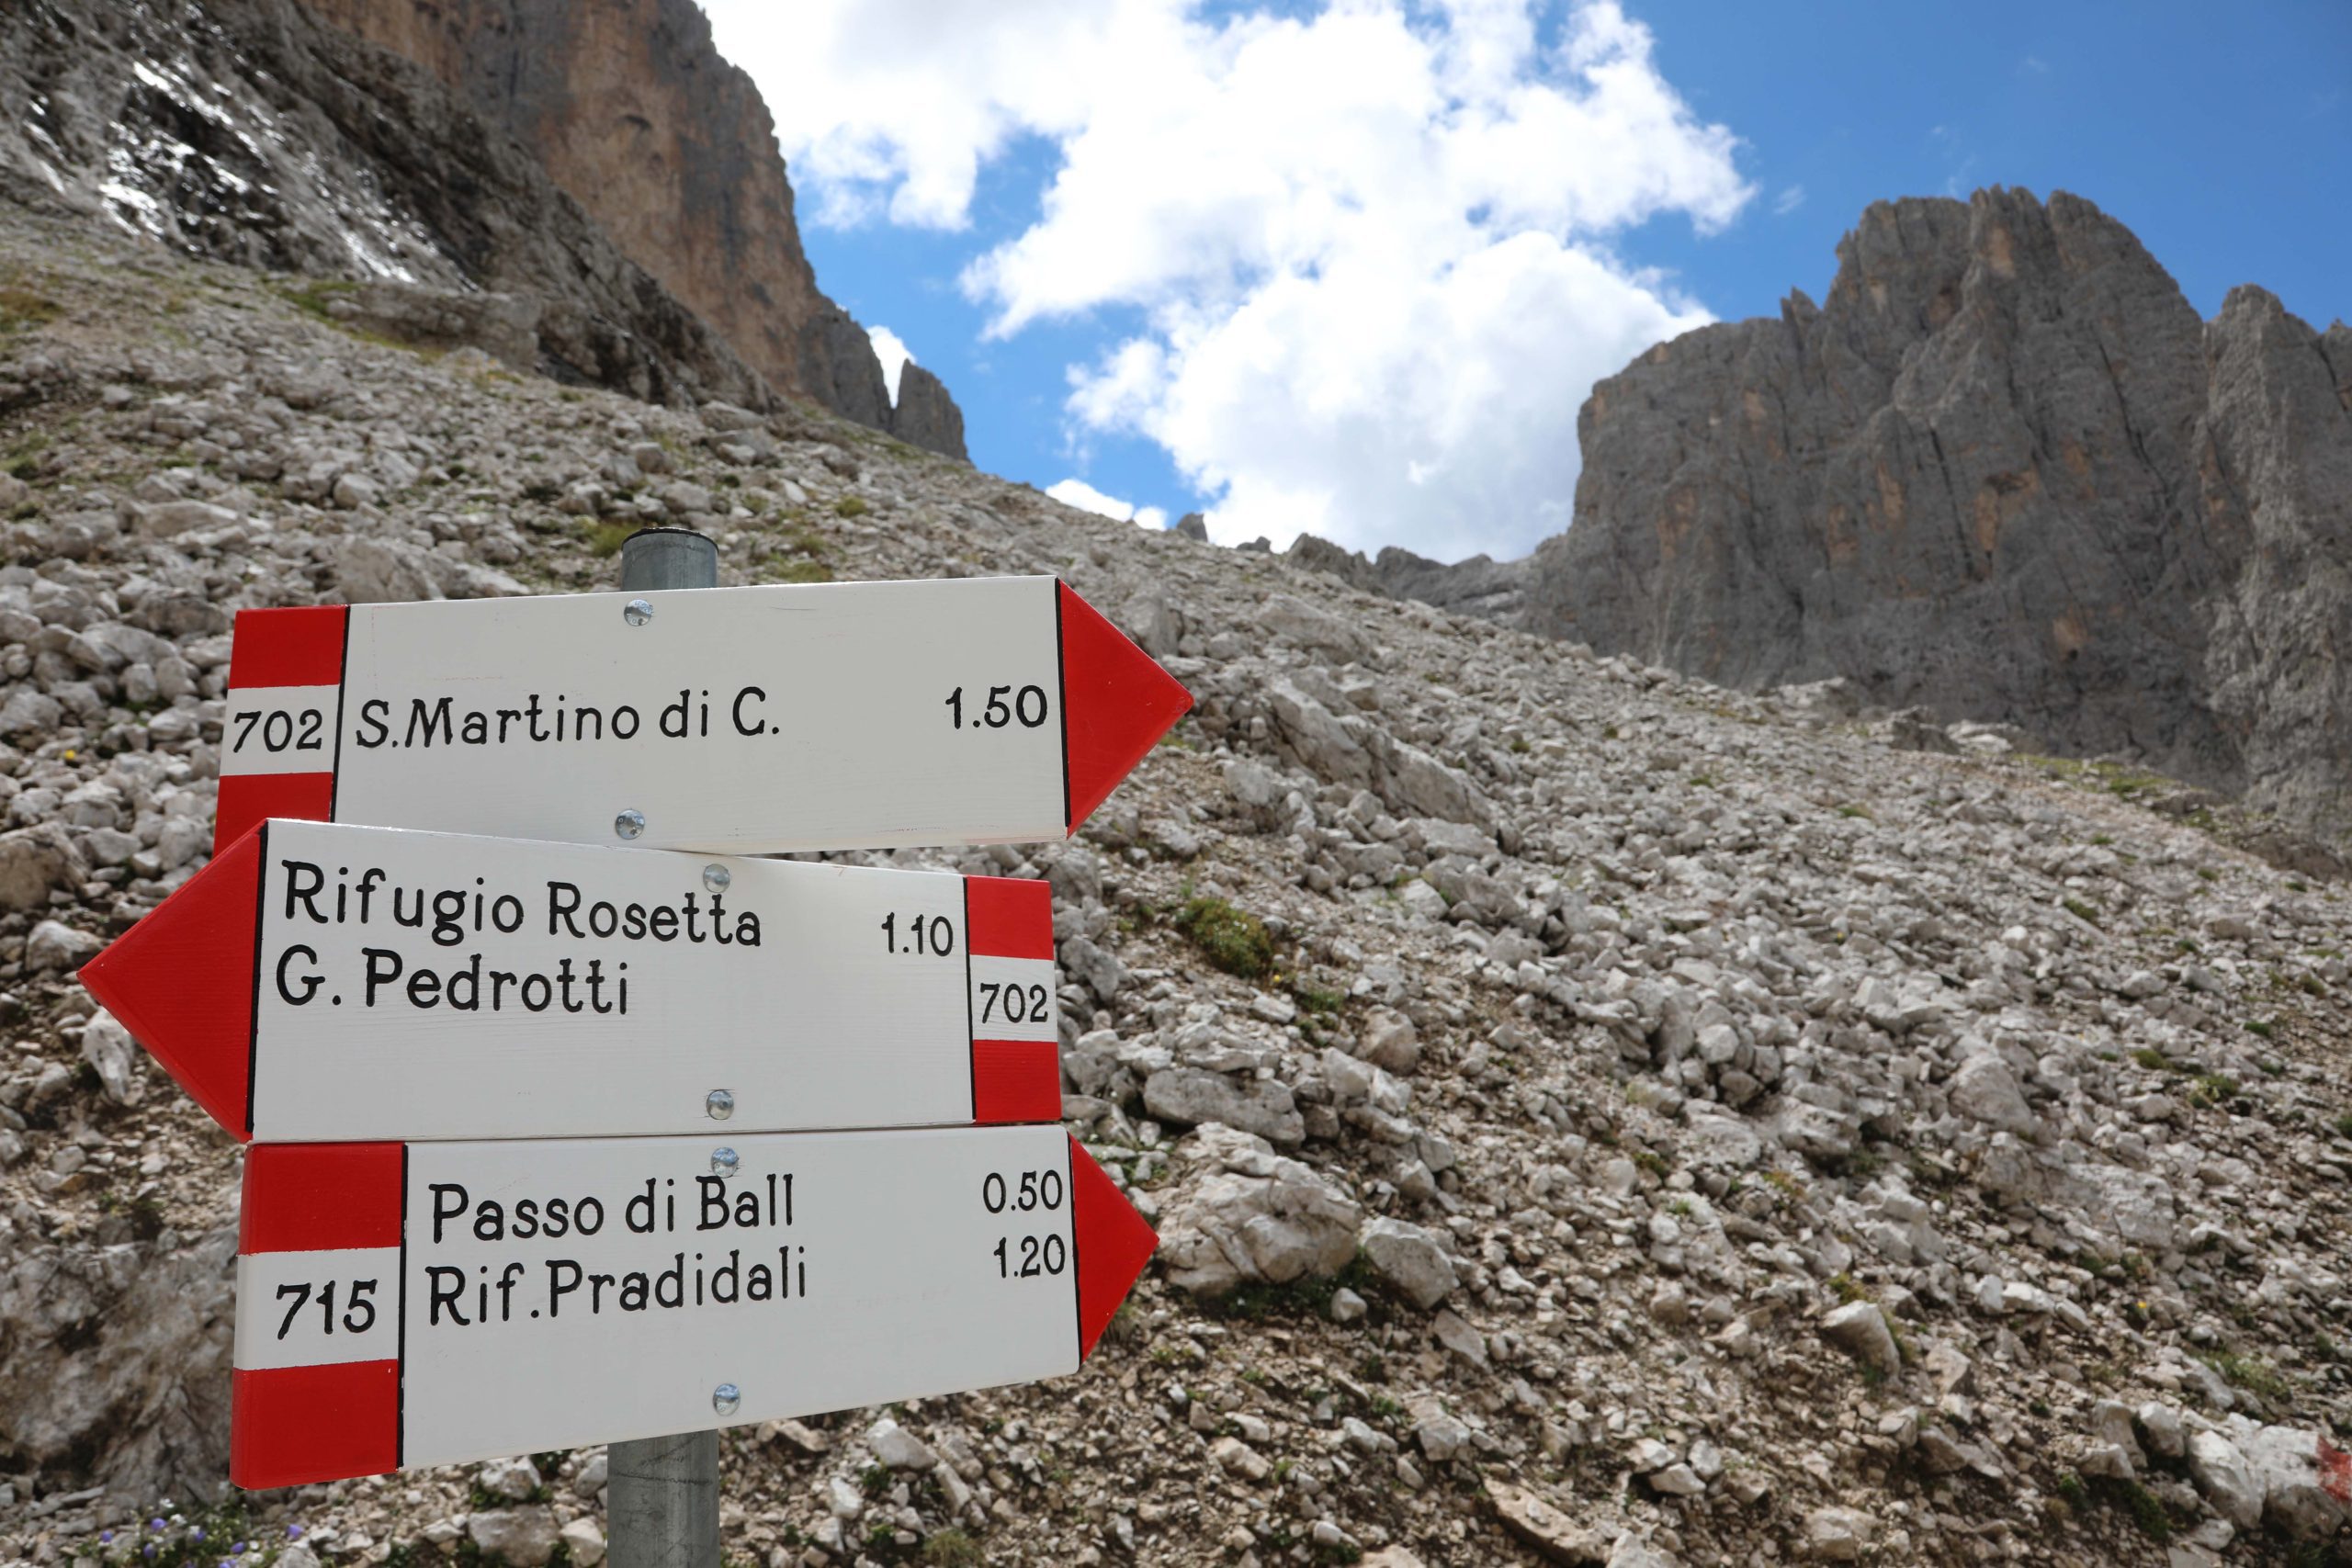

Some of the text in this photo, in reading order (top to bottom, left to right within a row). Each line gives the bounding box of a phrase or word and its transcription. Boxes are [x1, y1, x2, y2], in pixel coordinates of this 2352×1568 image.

[232, 709, 323, 753] 702
[355, 685, 781, 750] S.Martino di C.
[944, 684, 1048, 731] 1.50
[281, 859, 763, 948] Rifugio Rosetta
[879, 911, 954, 957] 1.10
[276, 943, 628, 1016] G. Pedrotti
[979, 982, 1049, 1024] 702
[428, 1172, 795, 1245] Passo di Ball
[981, 1168, 1063, 1214] 0.50
[992, 1233, 1066, 1280] 1.20
[276, 1278, 379, 1341] 715
[424, 1244, 807, 1327] Rif.Pradidali
